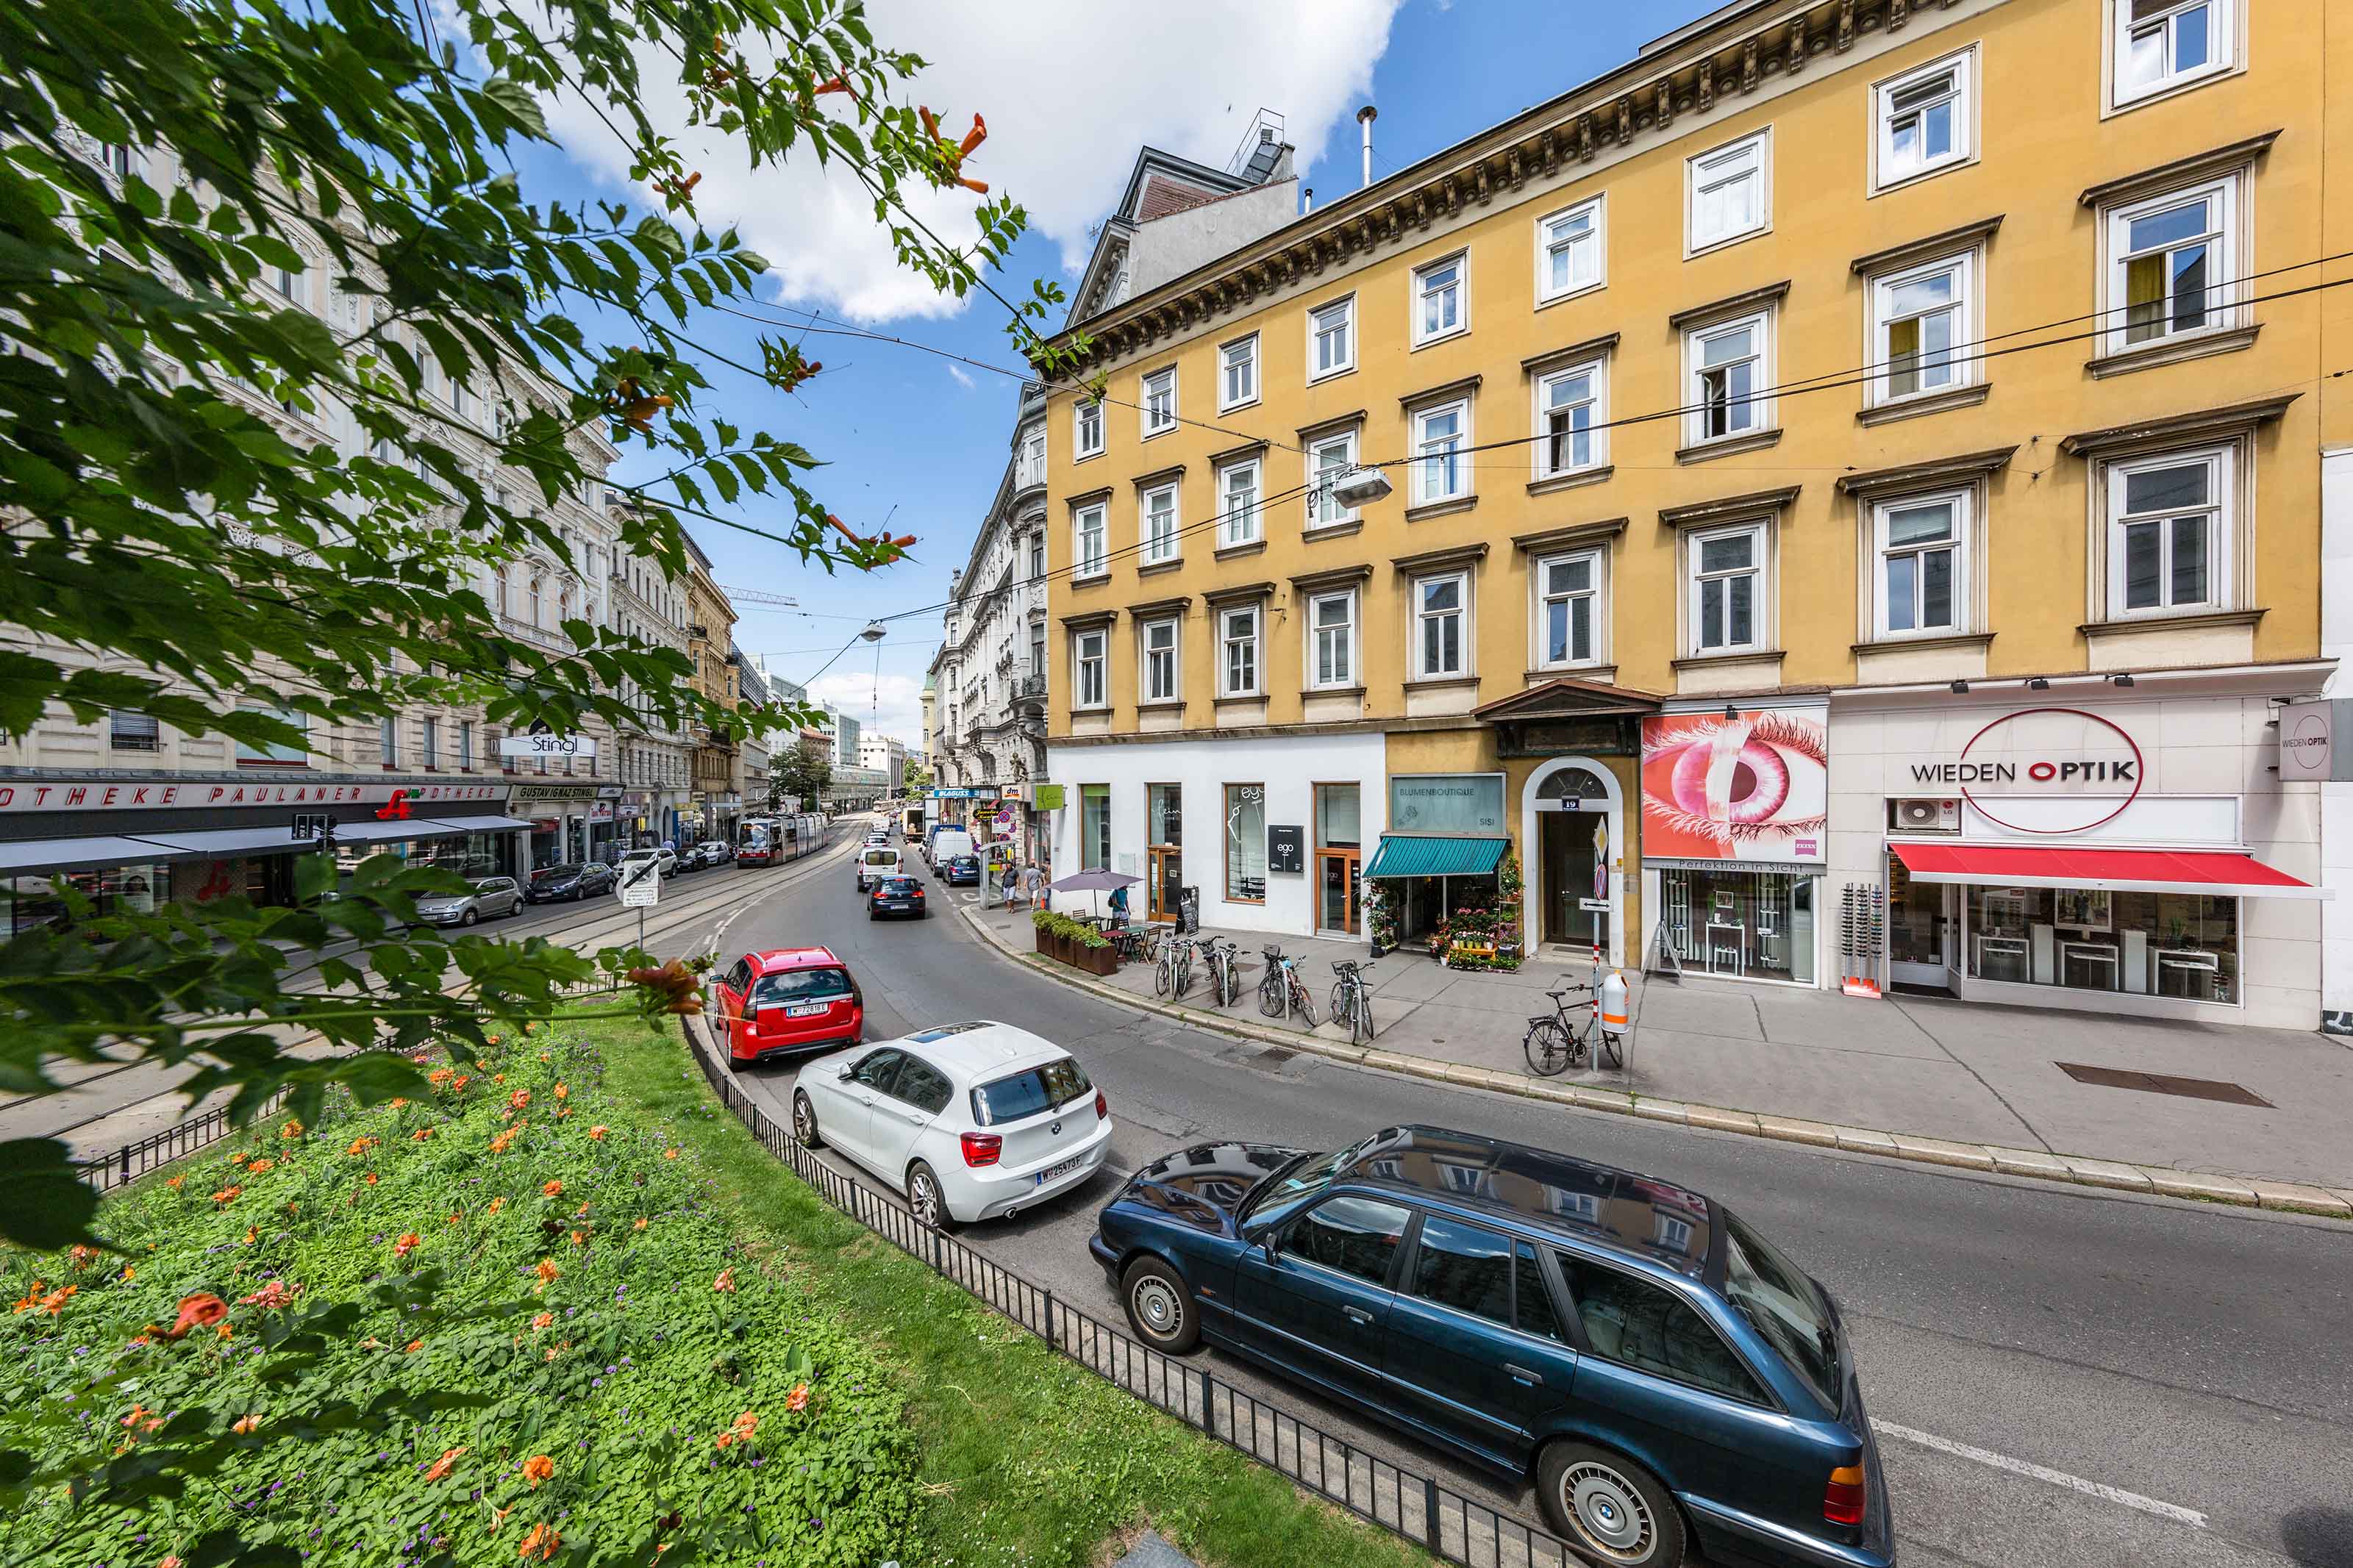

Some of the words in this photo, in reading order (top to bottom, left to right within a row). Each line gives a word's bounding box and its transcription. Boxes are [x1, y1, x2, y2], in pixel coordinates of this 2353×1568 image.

[532, 737, 577, 755] Stingl
[2282, 739, 2307, 748] WIEDEN
[2307, 737, 2327, 745] OPTIK
[1912, 763, 2015, 781] WIEDEN
[2029, 762, 2135, 781] OPTIK
[208, 787, 361, 803] PAULANER
[407, 787, 495, 799] POTHEKE
[520, 787, 550, 798] GUSTAV
[550, 787, 572, 798] IGNAZ
[572, 787, 593, 797] STINGL
[1399, 788, 1475, 796] BLUMENBOUTIQUE
[1479, 817, 1495, 826] SISI
[1277, 844, 1294, 853] ego
[1679, 859, 1746, 870] Perfektion
[1751, 862, 1763, 871] in
[1768, 863, 1803, 873] Sicht
